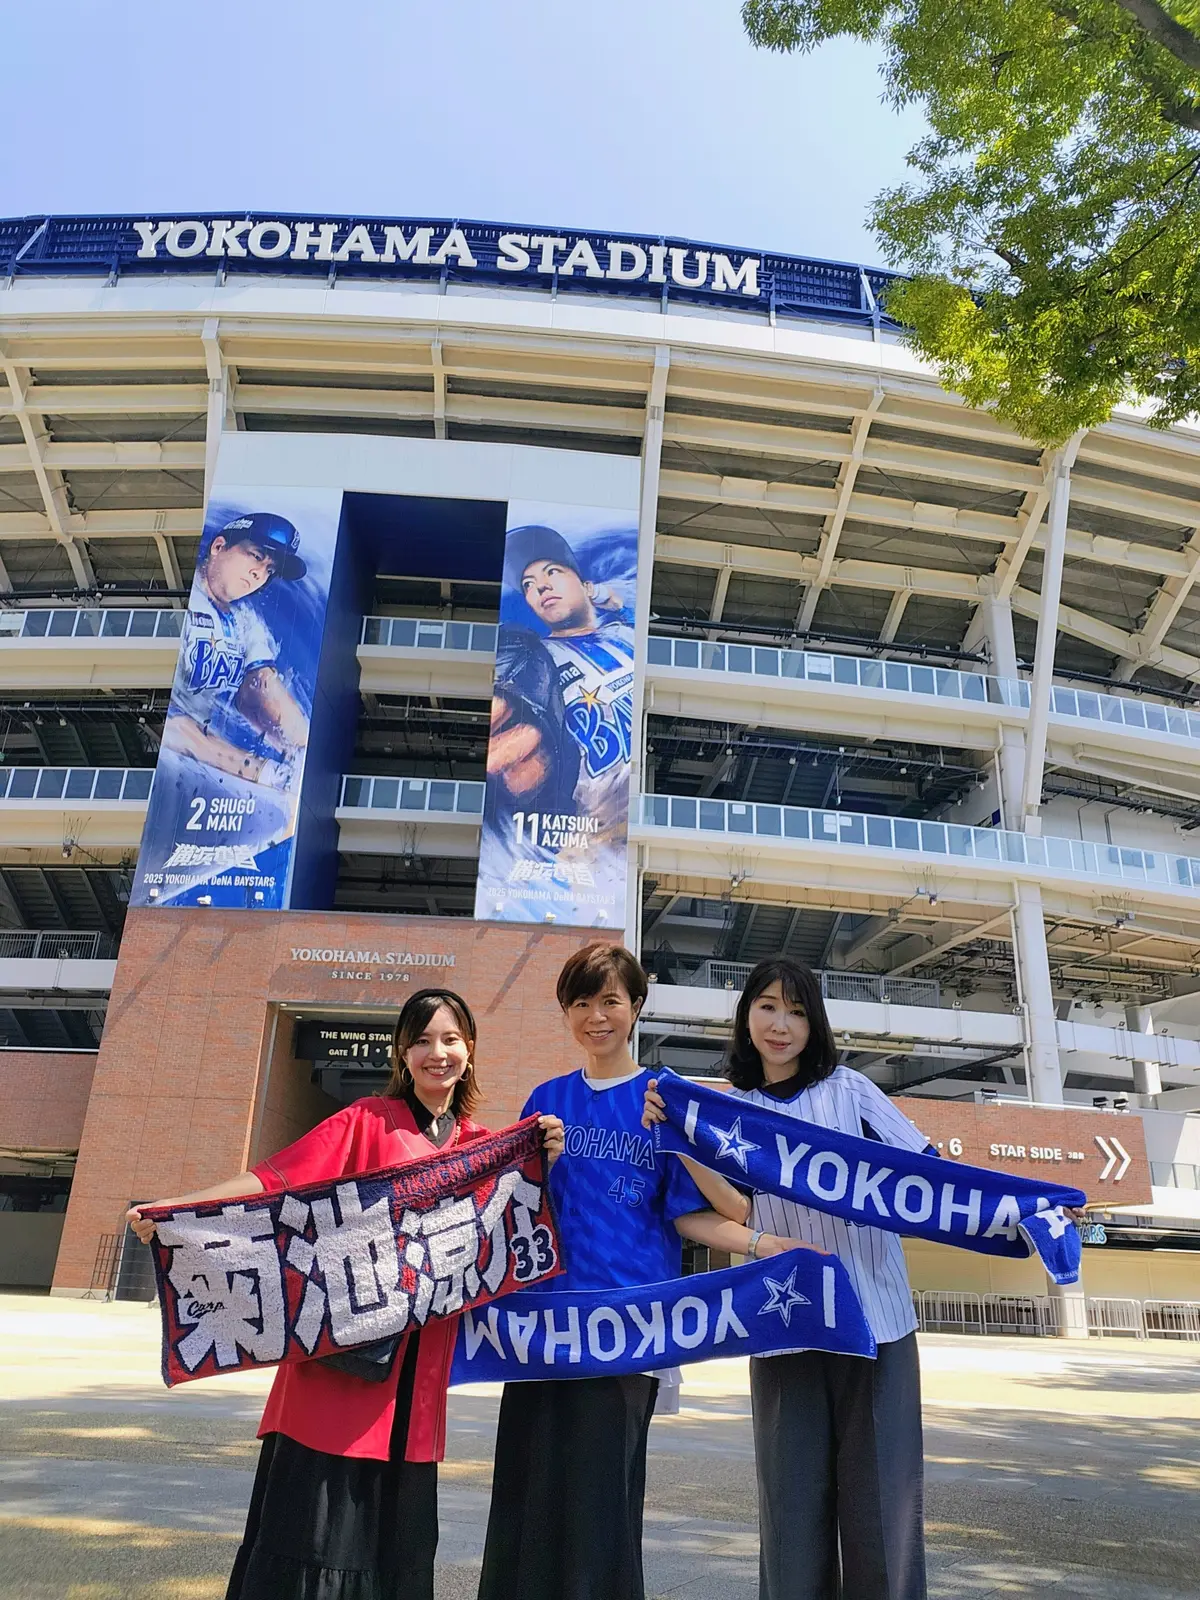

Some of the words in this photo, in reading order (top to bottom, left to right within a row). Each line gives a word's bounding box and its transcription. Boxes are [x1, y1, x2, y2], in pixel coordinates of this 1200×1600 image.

[133, 219, 478, 268] YOKOHAMA
[496, 233, 761, 297] STADIUM
[186, 797, 206, 830] 2
[210, 797, 256, 814] SHUGO
[206, 815, 243, 831] MAKI
[512, 811, 539, 845] 11
[542, 813, 598, 833] KATSUKI
[541, 832, 588, 849] AZUMA
[144, 873, 163, 884] 2025
[165, 874, 208, 885] YOKOHAMA
[211, 875, 232, 886] DeNA
[234, 876, 275, 887] BAYSTARS
[290, 948, 381, 964] YOKOHAMA
[385, 952, 456, 967] STADIUM
[331, 970, 372, 981] SINCE
[380, 973, 410, 982] 1978
[320, 1031, 338, 1039] THE
[341, 1032, 366, 1040] WING
[368, 1033, 392, 1042] STAR
[990, 1143, 1026, 1159] STAR
[1030, 1146, 1063, 1160] SIDE
[607, 1175, 646, 1208] 45
[511, 1226, 556, 1280] 33
[155, 1169, 541, 1372] 菊池涼介
[187, 1300, 228, 1319] Carp
